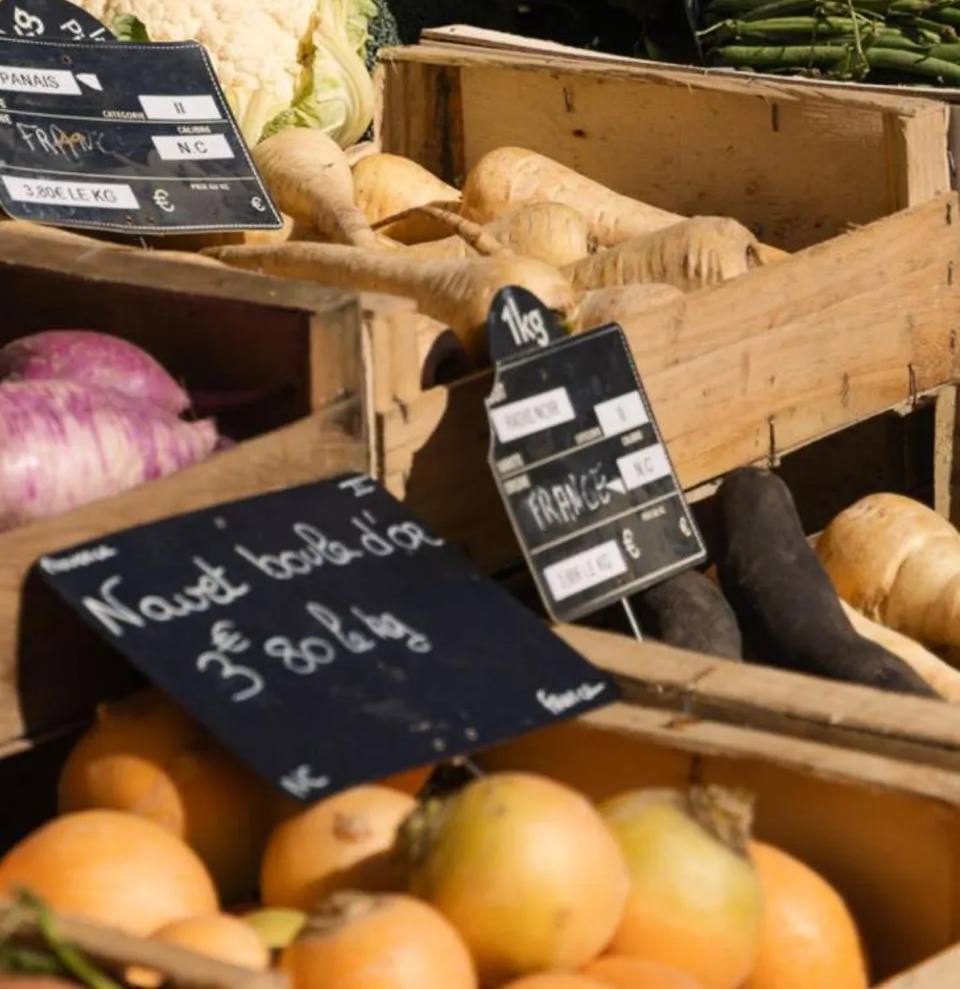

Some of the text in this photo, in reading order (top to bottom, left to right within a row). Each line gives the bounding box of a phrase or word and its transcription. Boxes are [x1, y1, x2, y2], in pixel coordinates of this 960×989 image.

[178, 140, 210, 156] N.C
[70, 187, 90, 204] LE
[91, 188, 119, 205] KG
[500, 296, 550, 348] 1kg
[527, 460, 611, 532] FRANCE
[83, 556, 250, 637] Navet
[234, 522, 364, 580] boule
